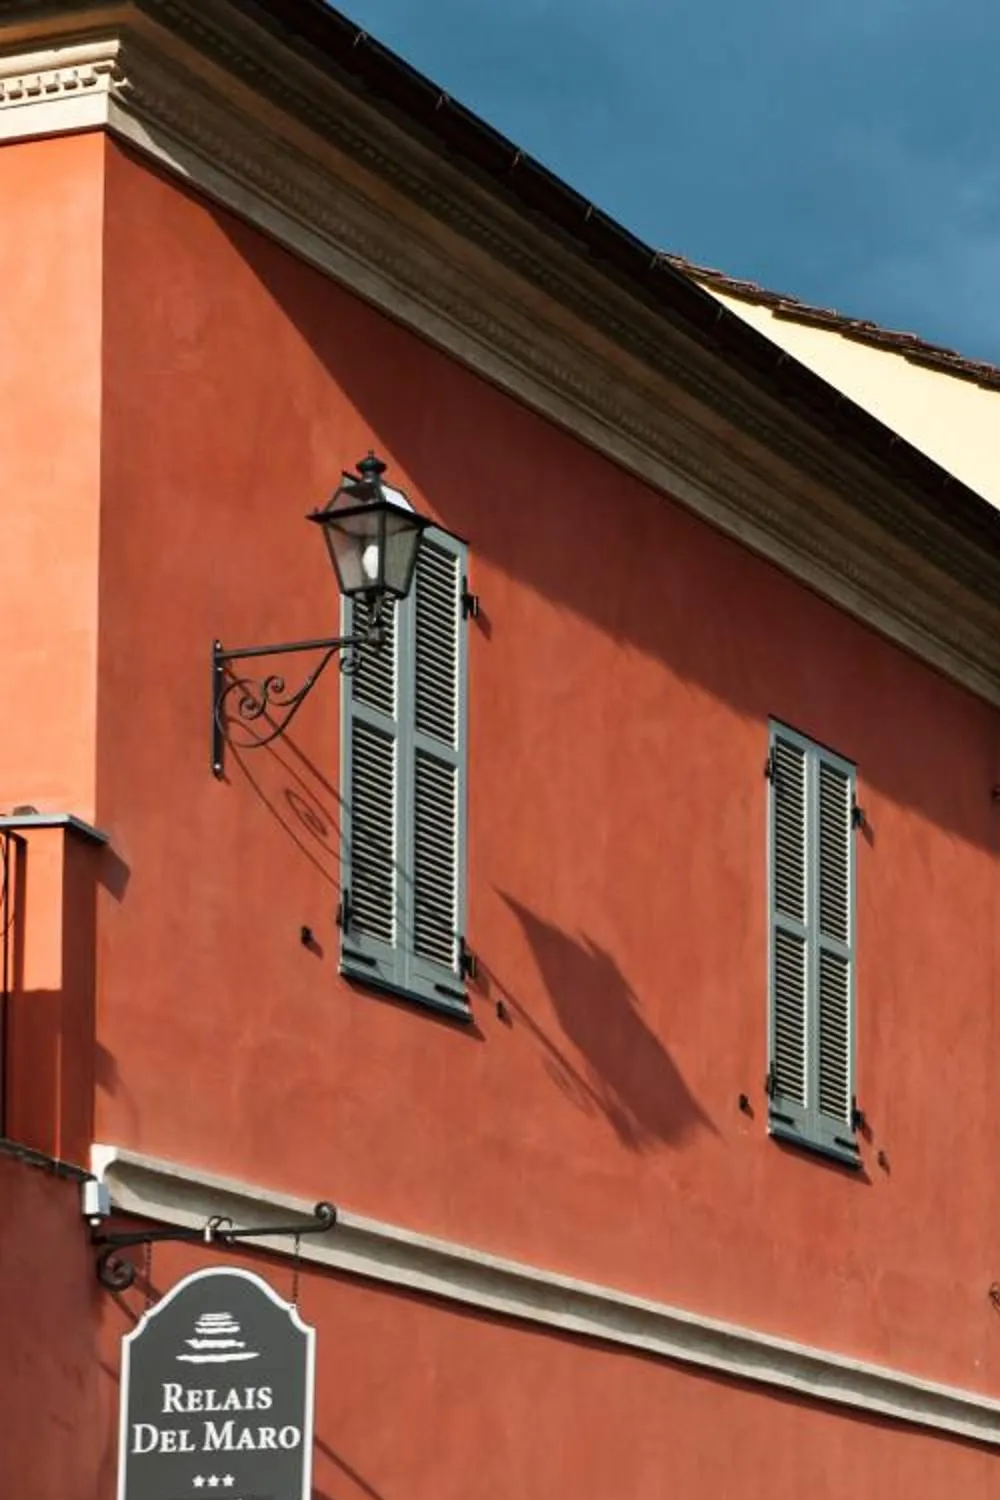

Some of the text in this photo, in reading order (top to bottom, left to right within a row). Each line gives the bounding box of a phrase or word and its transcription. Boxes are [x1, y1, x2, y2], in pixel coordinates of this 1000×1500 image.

[161, 1383, 273, 1413] RELAIS
[131, 1420, 301, 1453] DEL MARO
